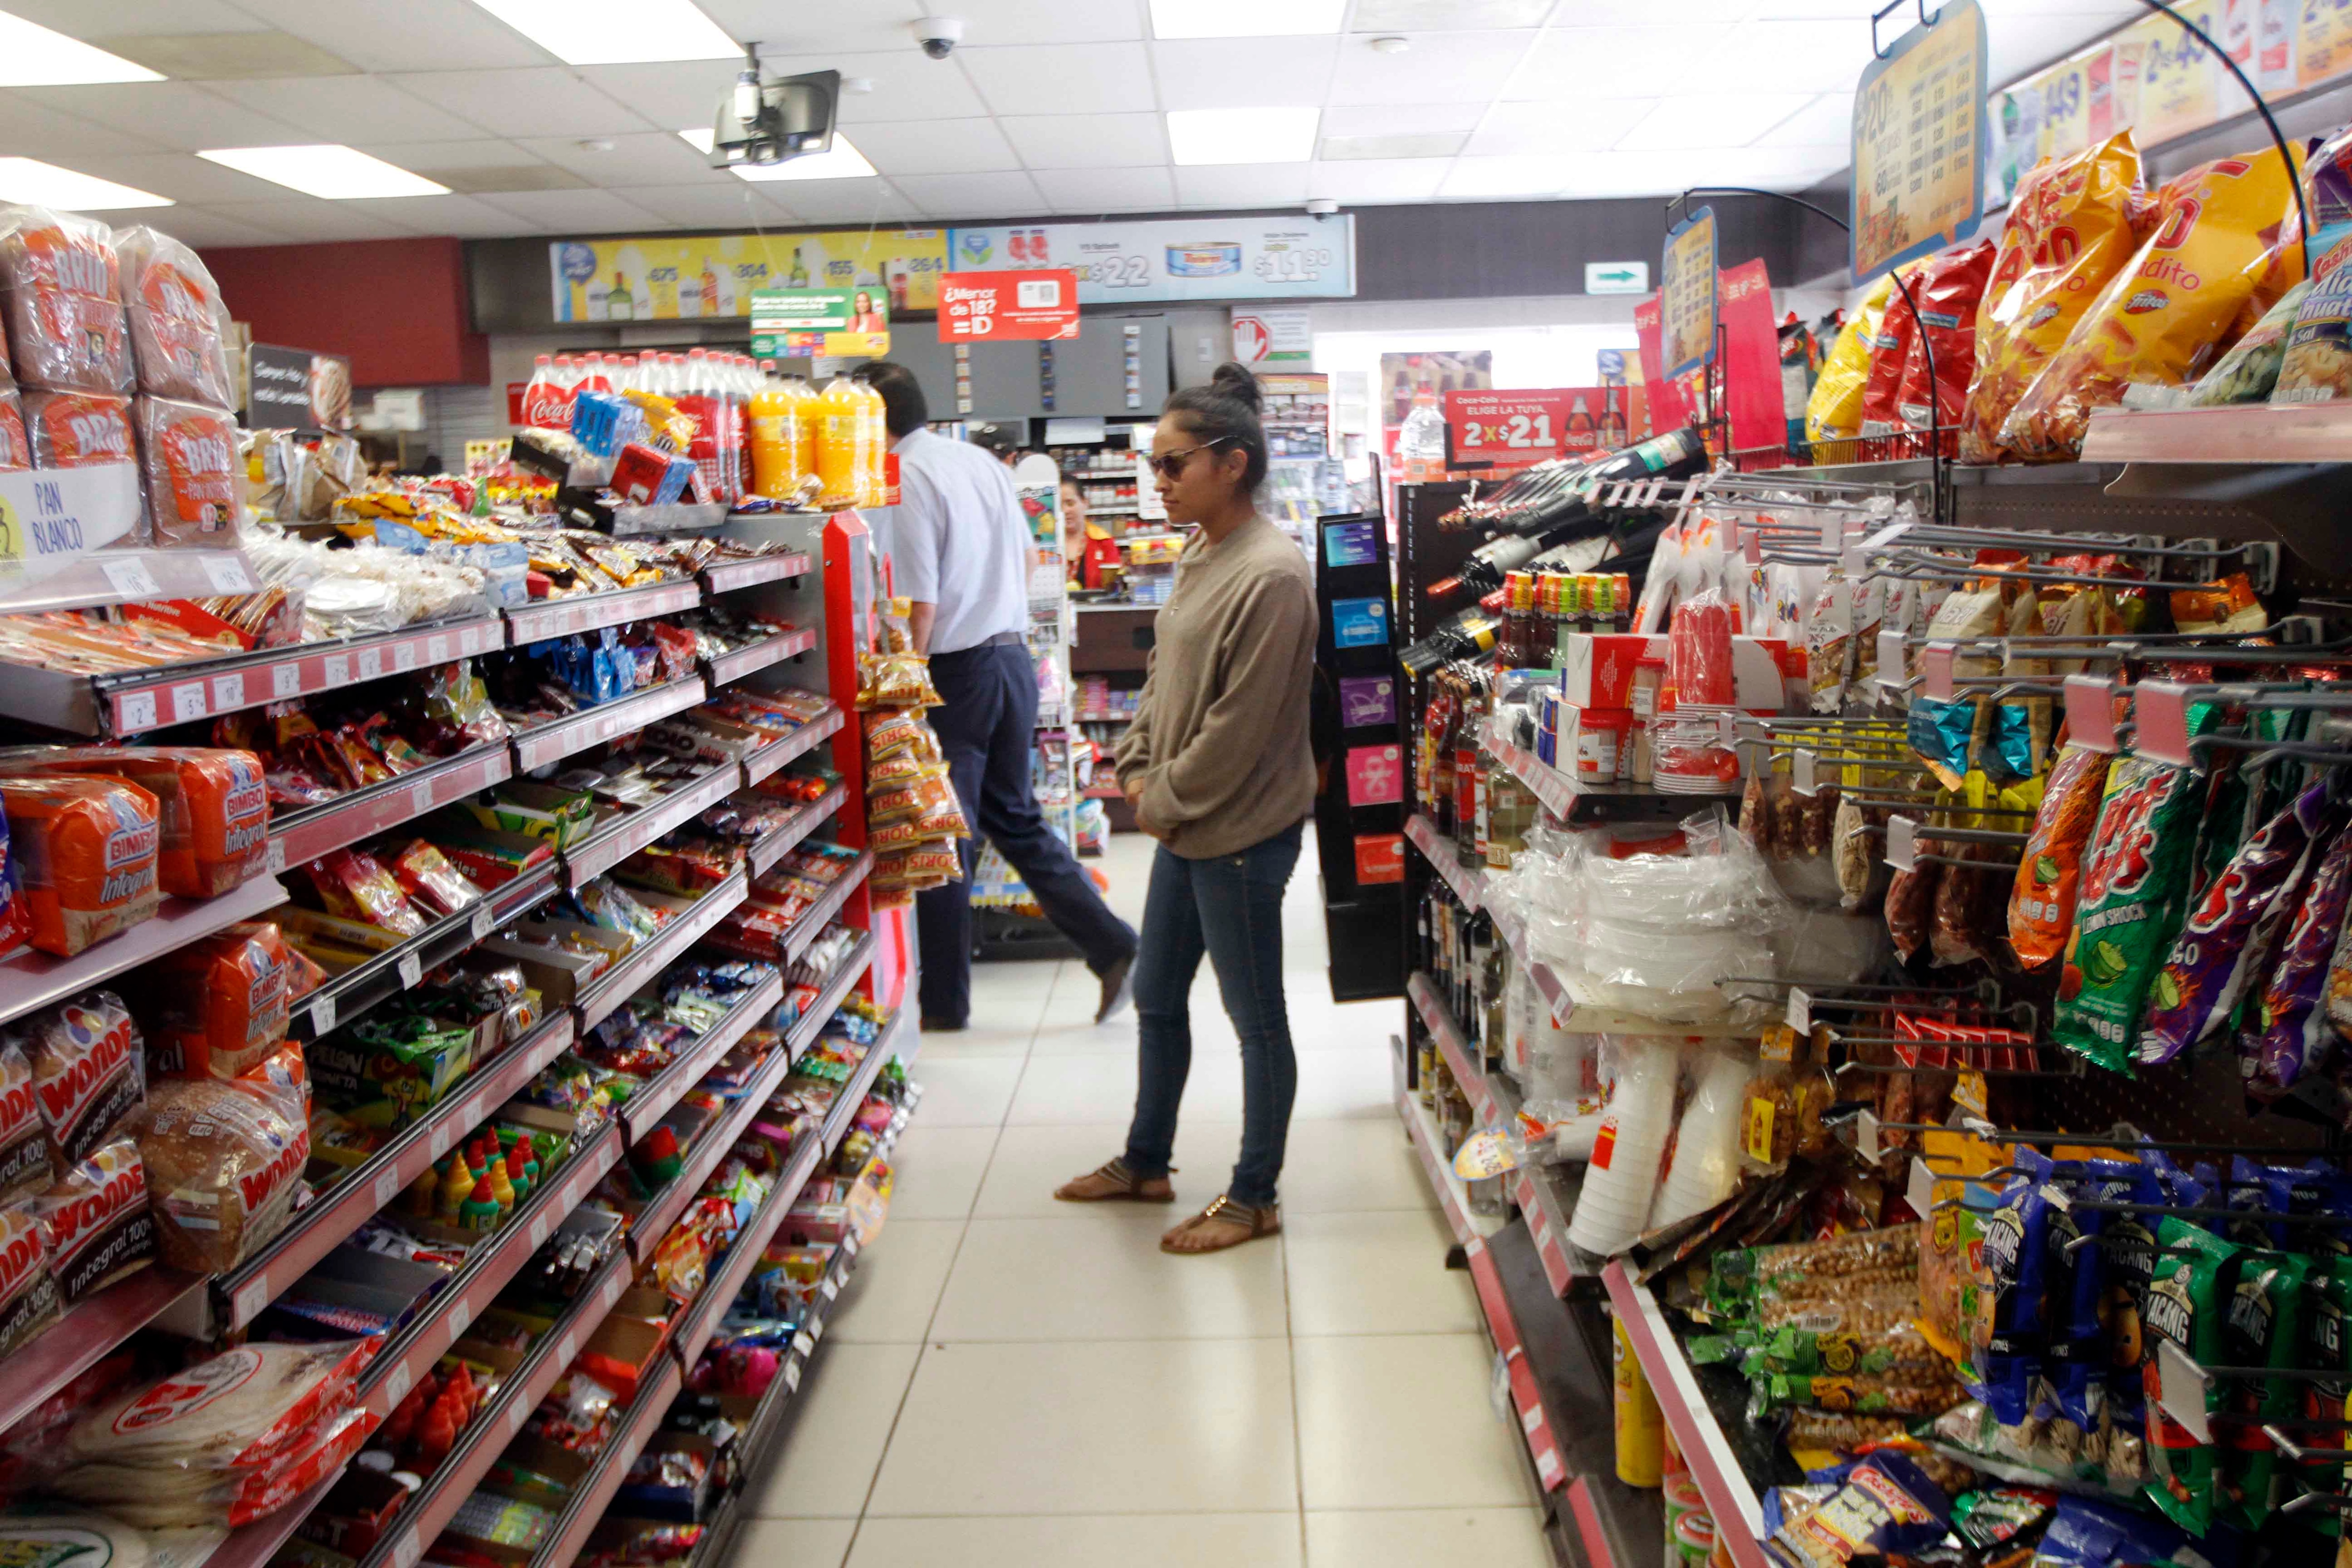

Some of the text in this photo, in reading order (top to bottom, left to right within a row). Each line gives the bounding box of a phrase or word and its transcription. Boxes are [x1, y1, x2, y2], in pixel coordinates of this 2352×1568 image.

[948, 304, 969, 316] de
[969, 298, 997, 315] 18?
[1466, 406, 1498, 415] ELIGE
[1500, 405, 1515, 415] LA
[34, 481, 64, 516] PAN
[32, 517, 84, 555] BLANCO
[227, 788, 264, 816] BIMBO
[224, 814, 267, 856] Integral
[99, 863, 157, 905] Integral
[72, 1227, 127, 1297] Integral
